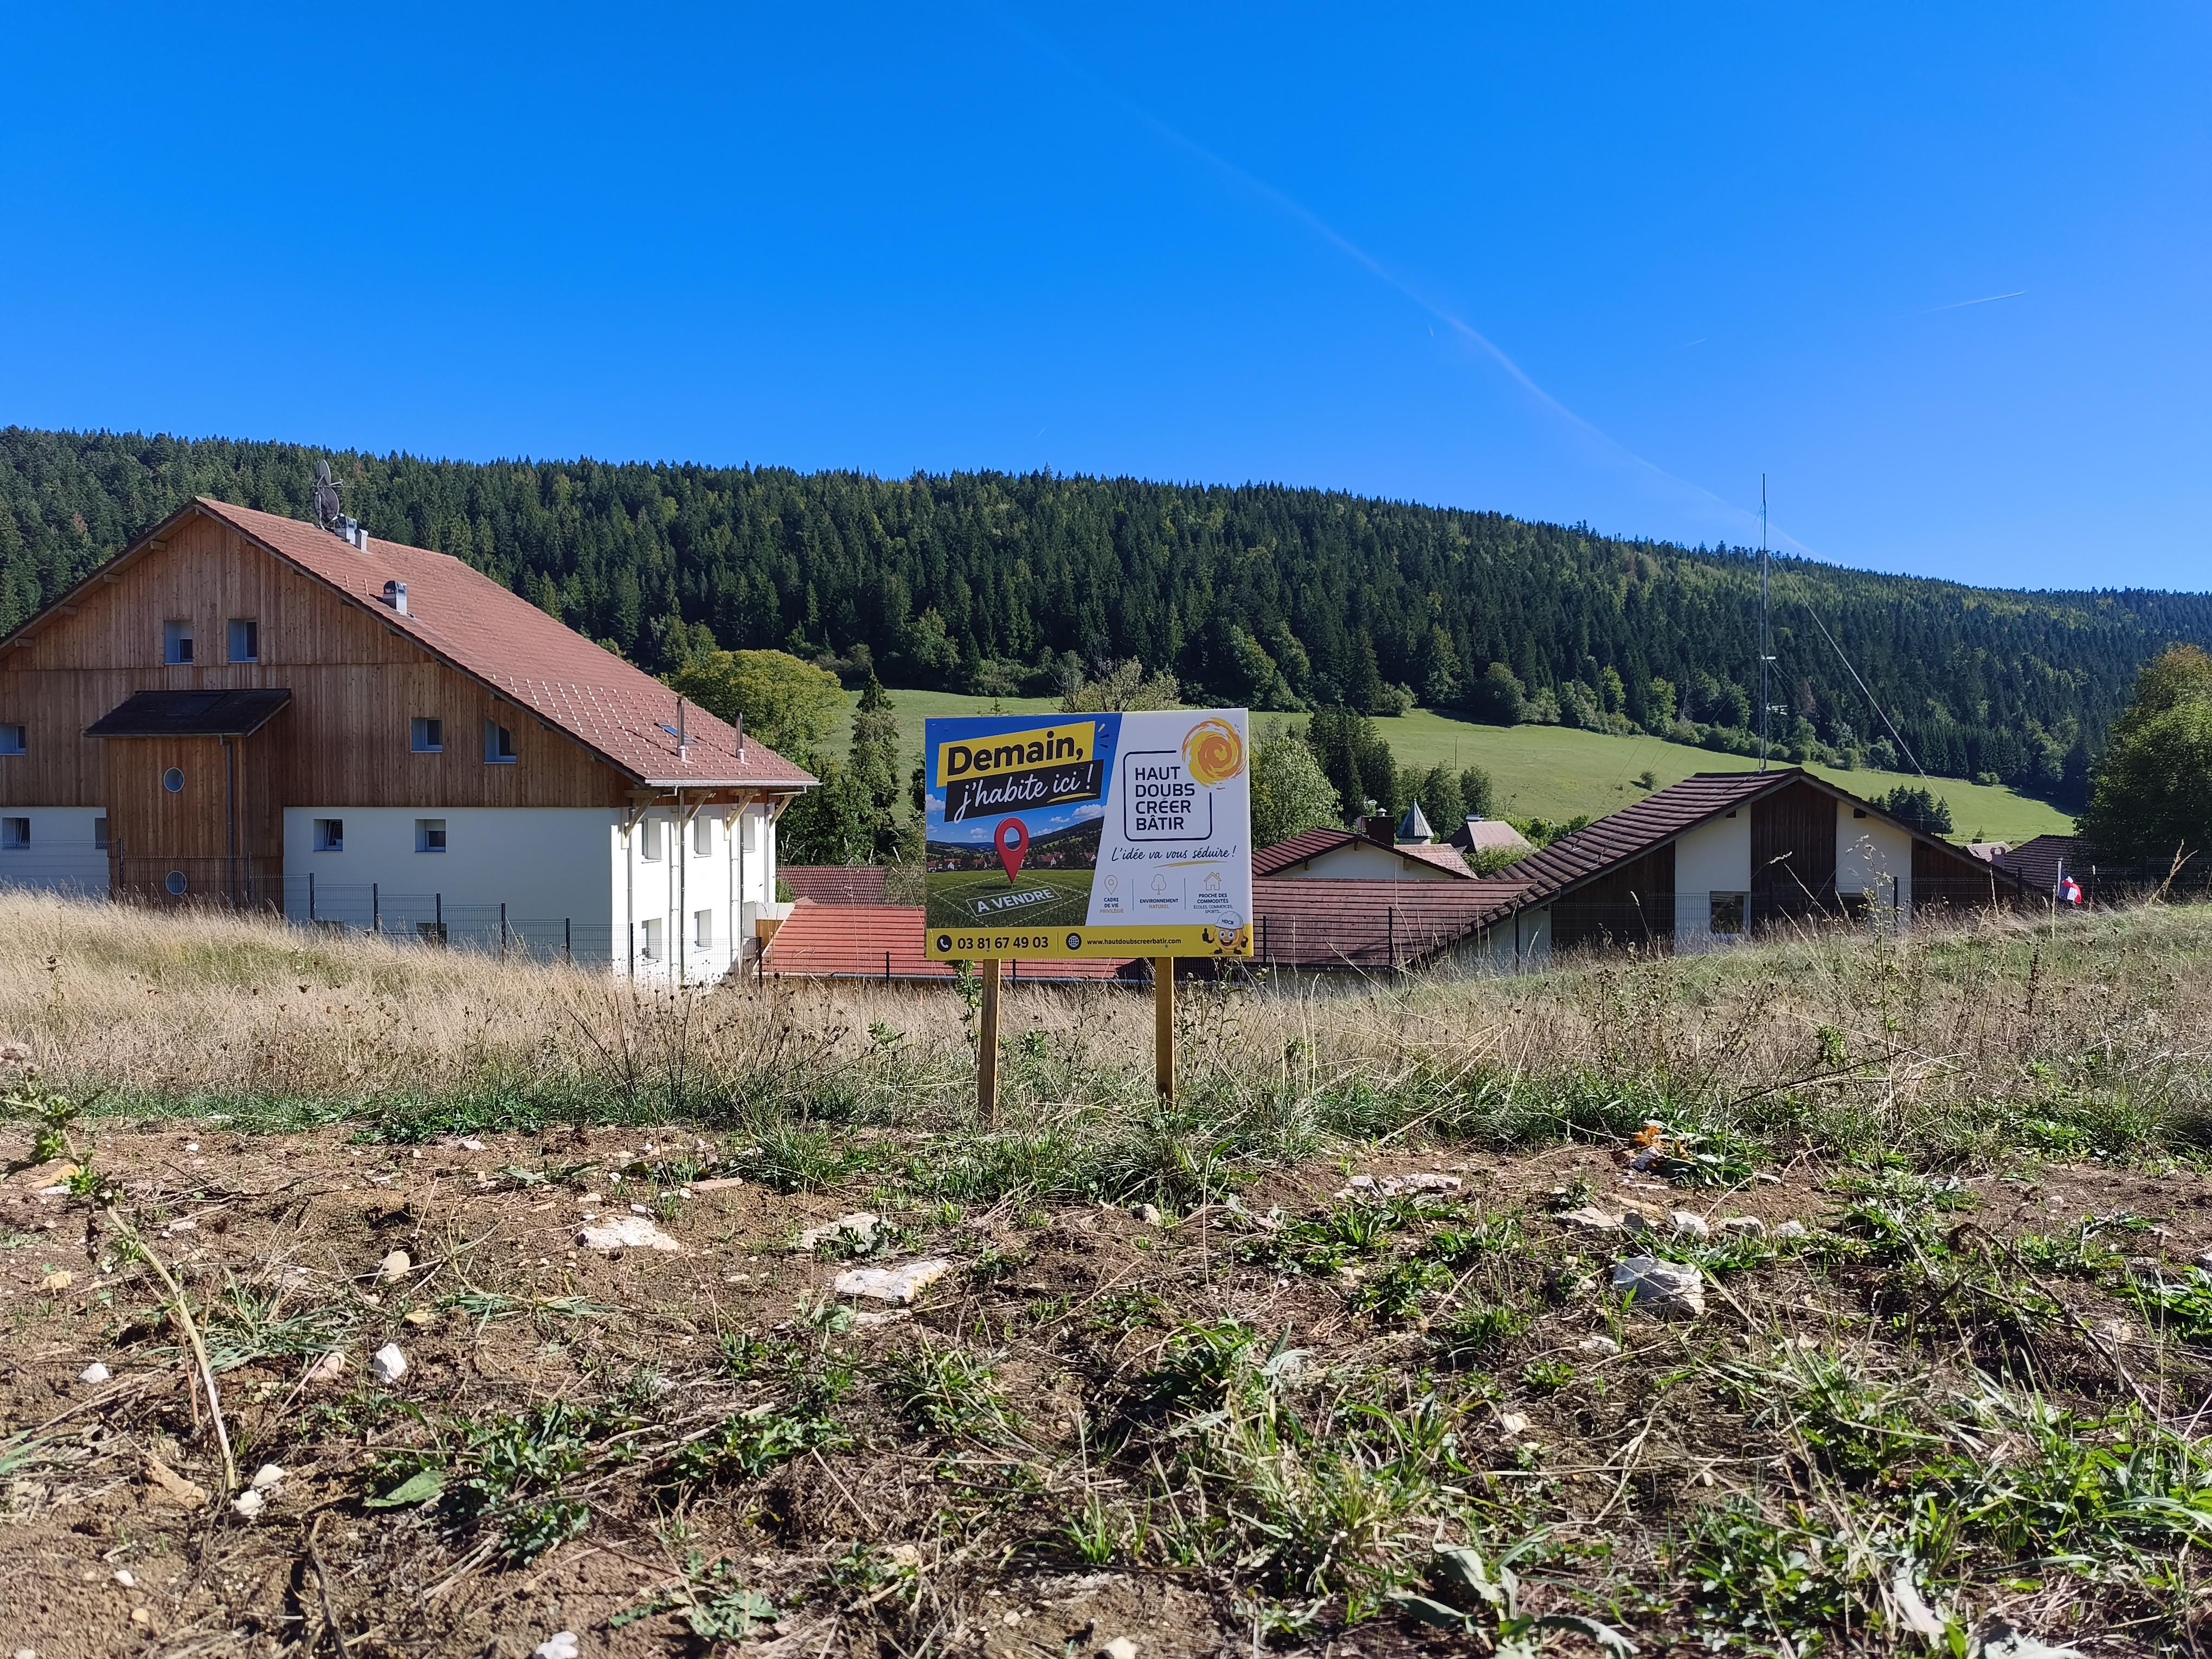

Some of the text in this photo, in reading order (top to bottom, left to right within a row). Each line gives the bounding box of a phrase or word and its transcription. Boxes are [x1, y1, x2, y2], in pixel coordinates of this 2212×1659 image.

[948, 731, 1083, 776] Demain,
[1135, 766, 1180, 781] HAUT
[954, 774, 1048, 824] j'habite
[1053, 771, 1080, 793] ici
[1135, 783, 1195, 798] DOUBS
[1136, 814, 1184, 831] BÂTIR
[1111, 846, 1145, 861] L'idée
[1166, 850, 1188, 859] vous
[1192, 846, 1230, 859] séduire
[978, 889, 1054, 912] A VENDRE
[957, 936, 1049, 949] 03 81 67 49 03
